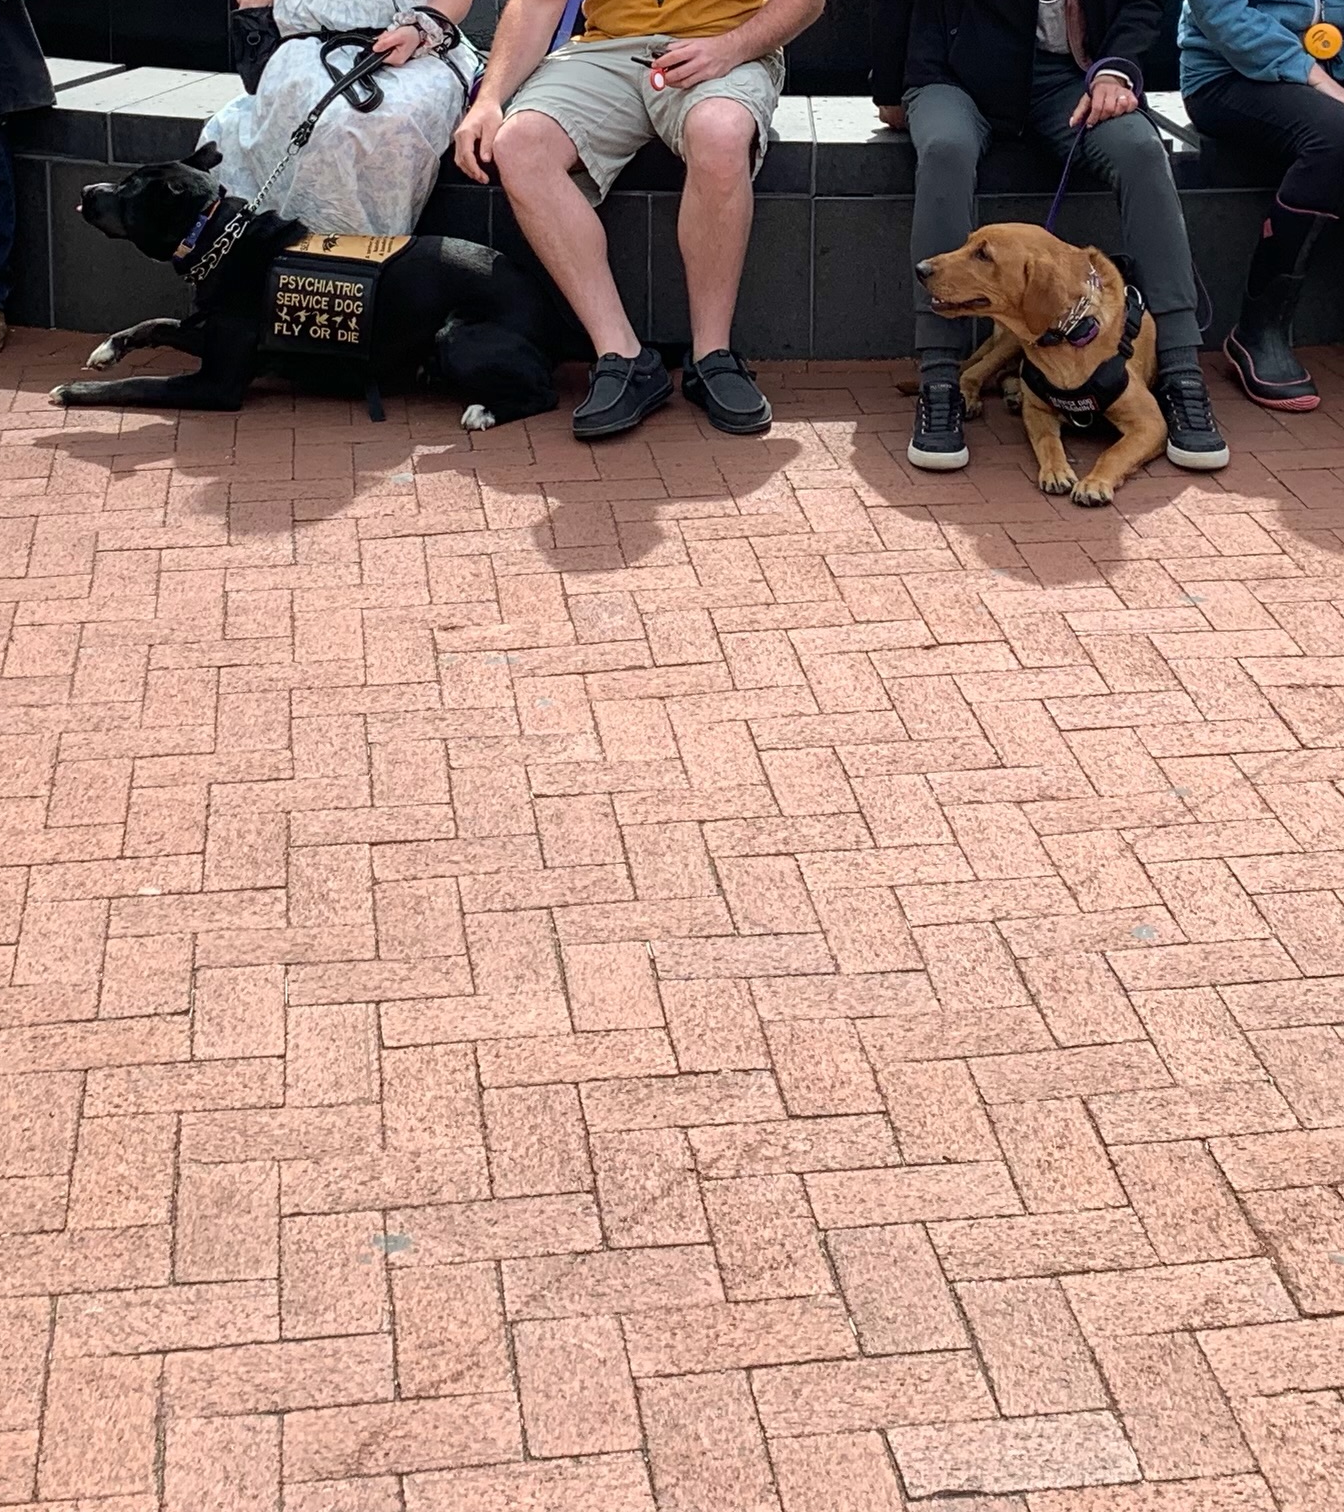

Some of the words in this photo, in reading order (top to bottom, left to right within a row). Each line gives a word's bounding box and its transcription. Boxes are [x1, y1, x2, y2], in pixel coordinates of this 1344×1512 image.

[279, 275, 364, 297] PSYCHIATRIC
[276, 291, 329, 310] SERVICE
[334, 298, 363, 315] DOG
[274, 322, 302, 336] FLY
[309, 325, 331, 339] OR
[337, 329, 360, 344] DIE
